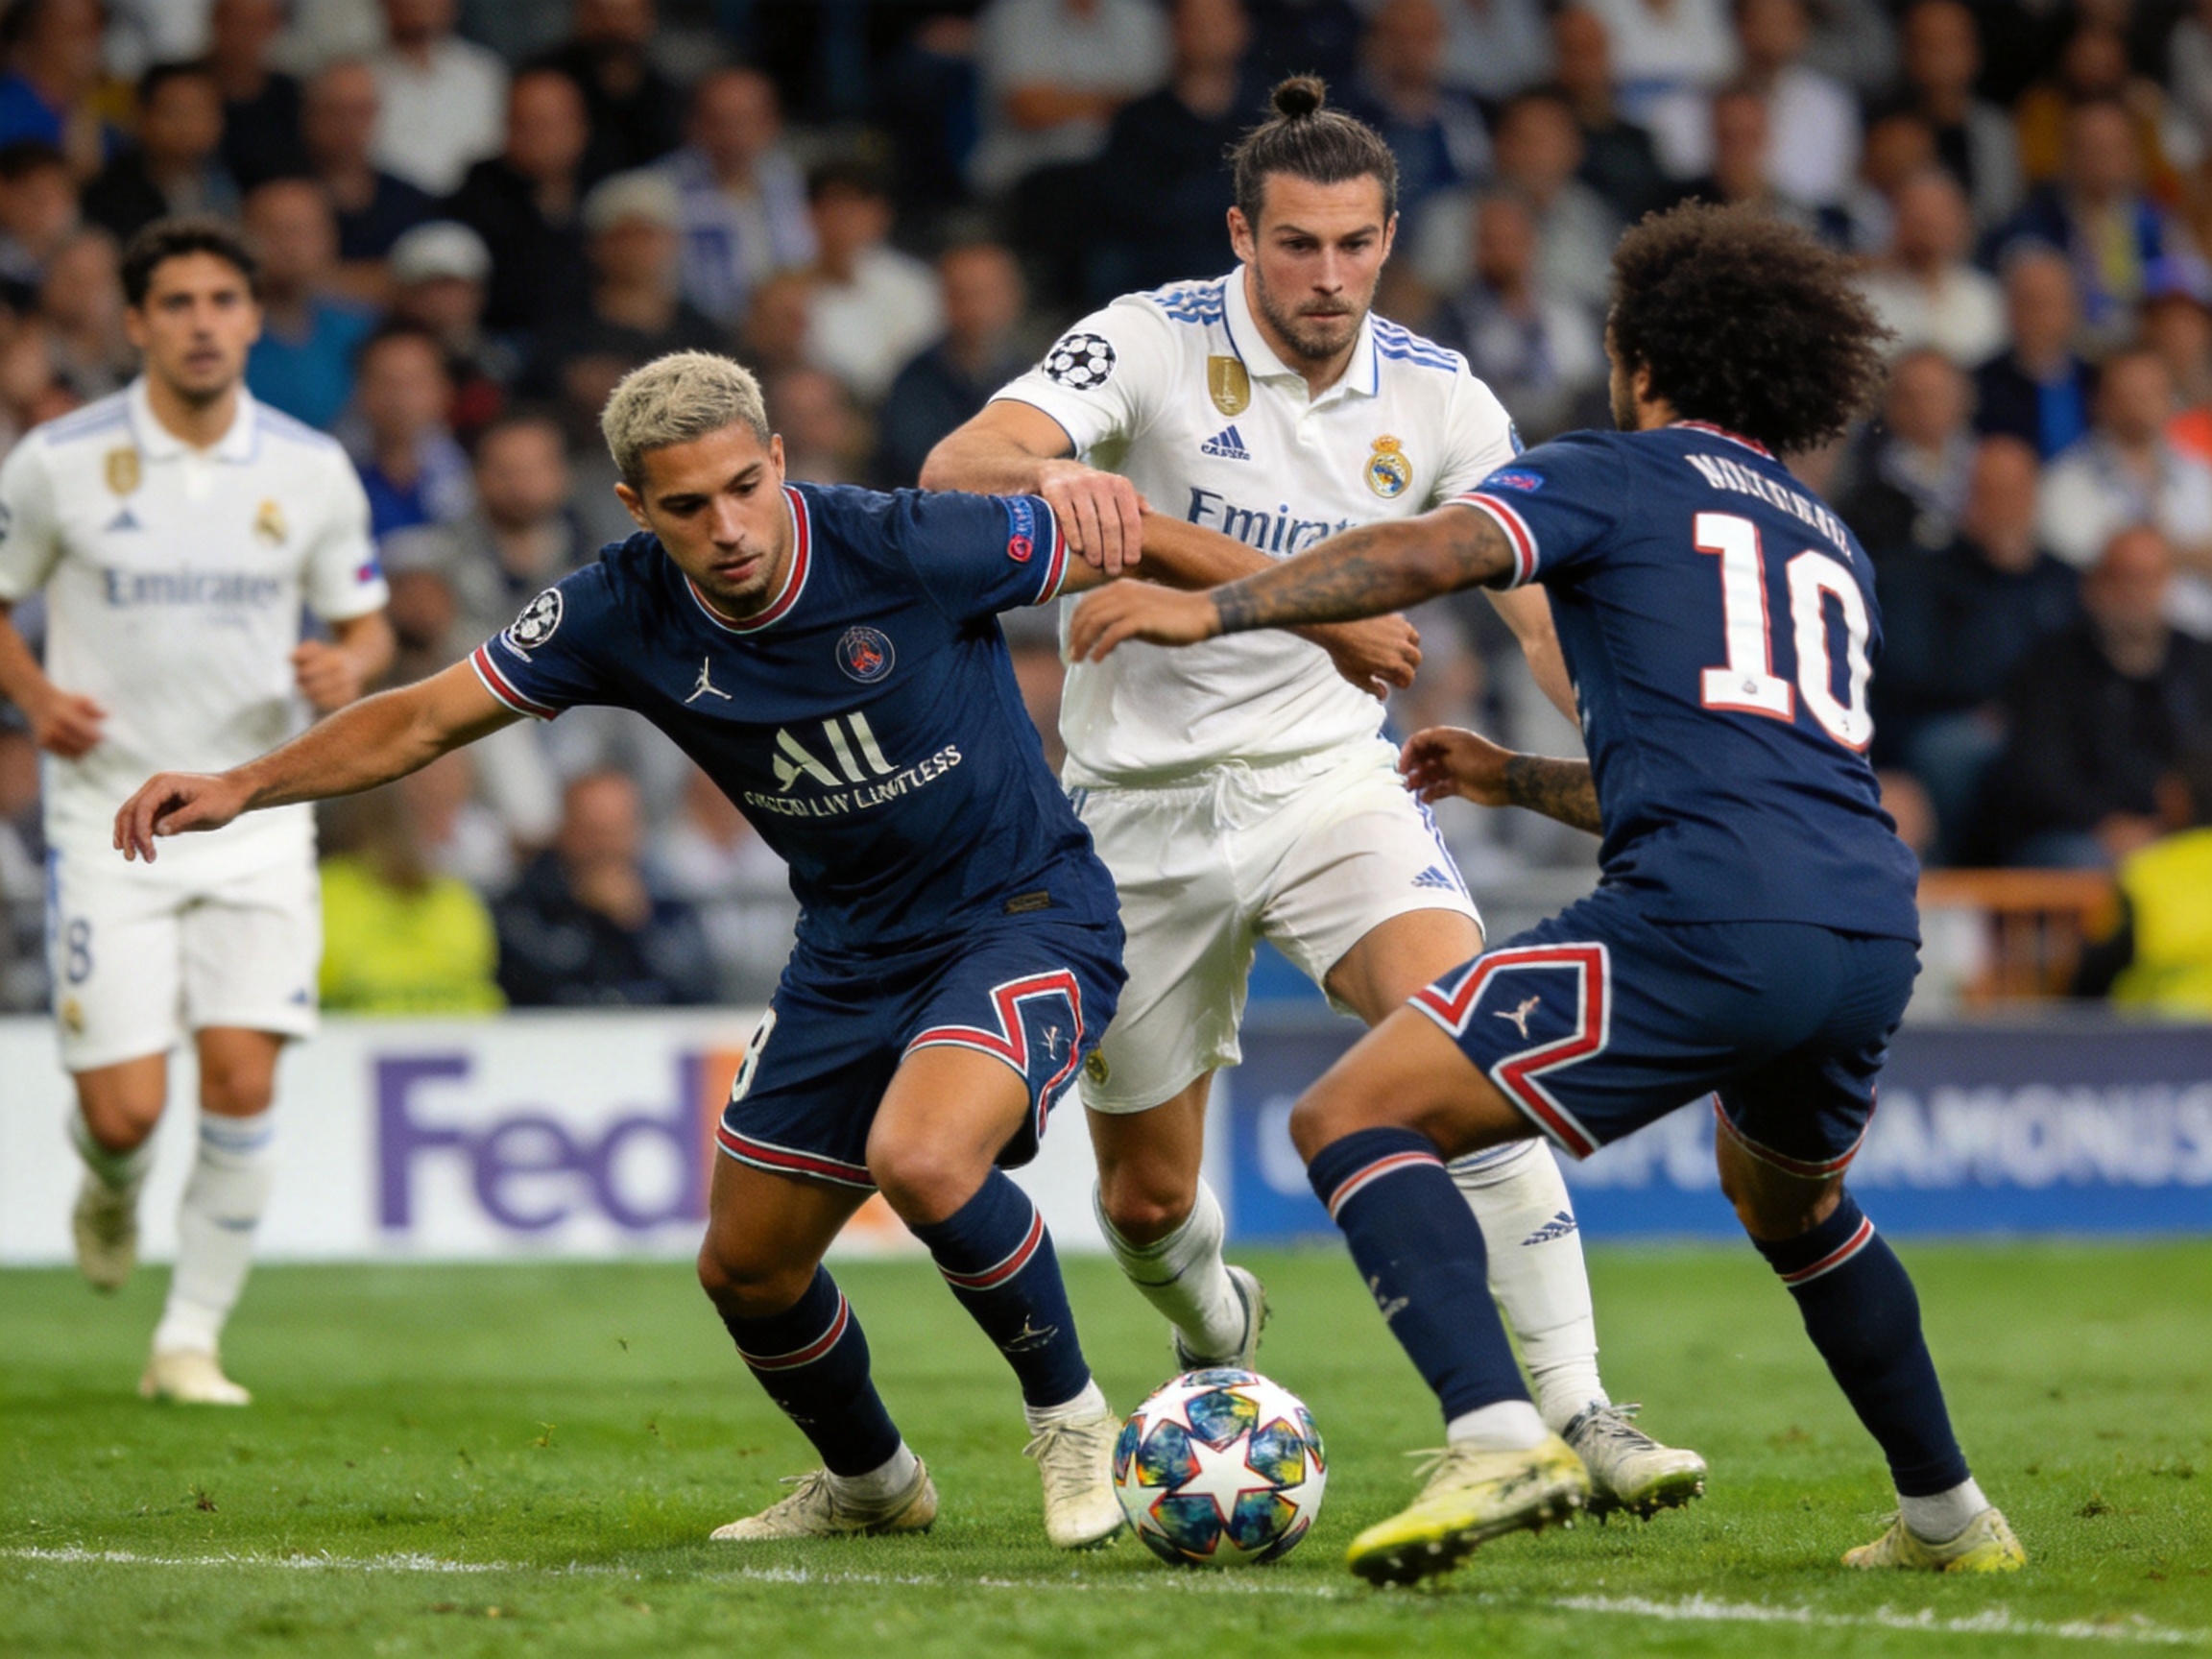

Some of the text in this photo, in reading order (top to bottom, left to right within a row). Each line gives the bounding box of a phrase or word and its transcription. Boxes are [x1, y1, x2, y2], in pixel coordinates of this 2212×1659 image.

[1188, 487, 1357, 554] Emira
[1693, 512, 1872, 754] 10
[375, 1050, 739, 1231] Fed
